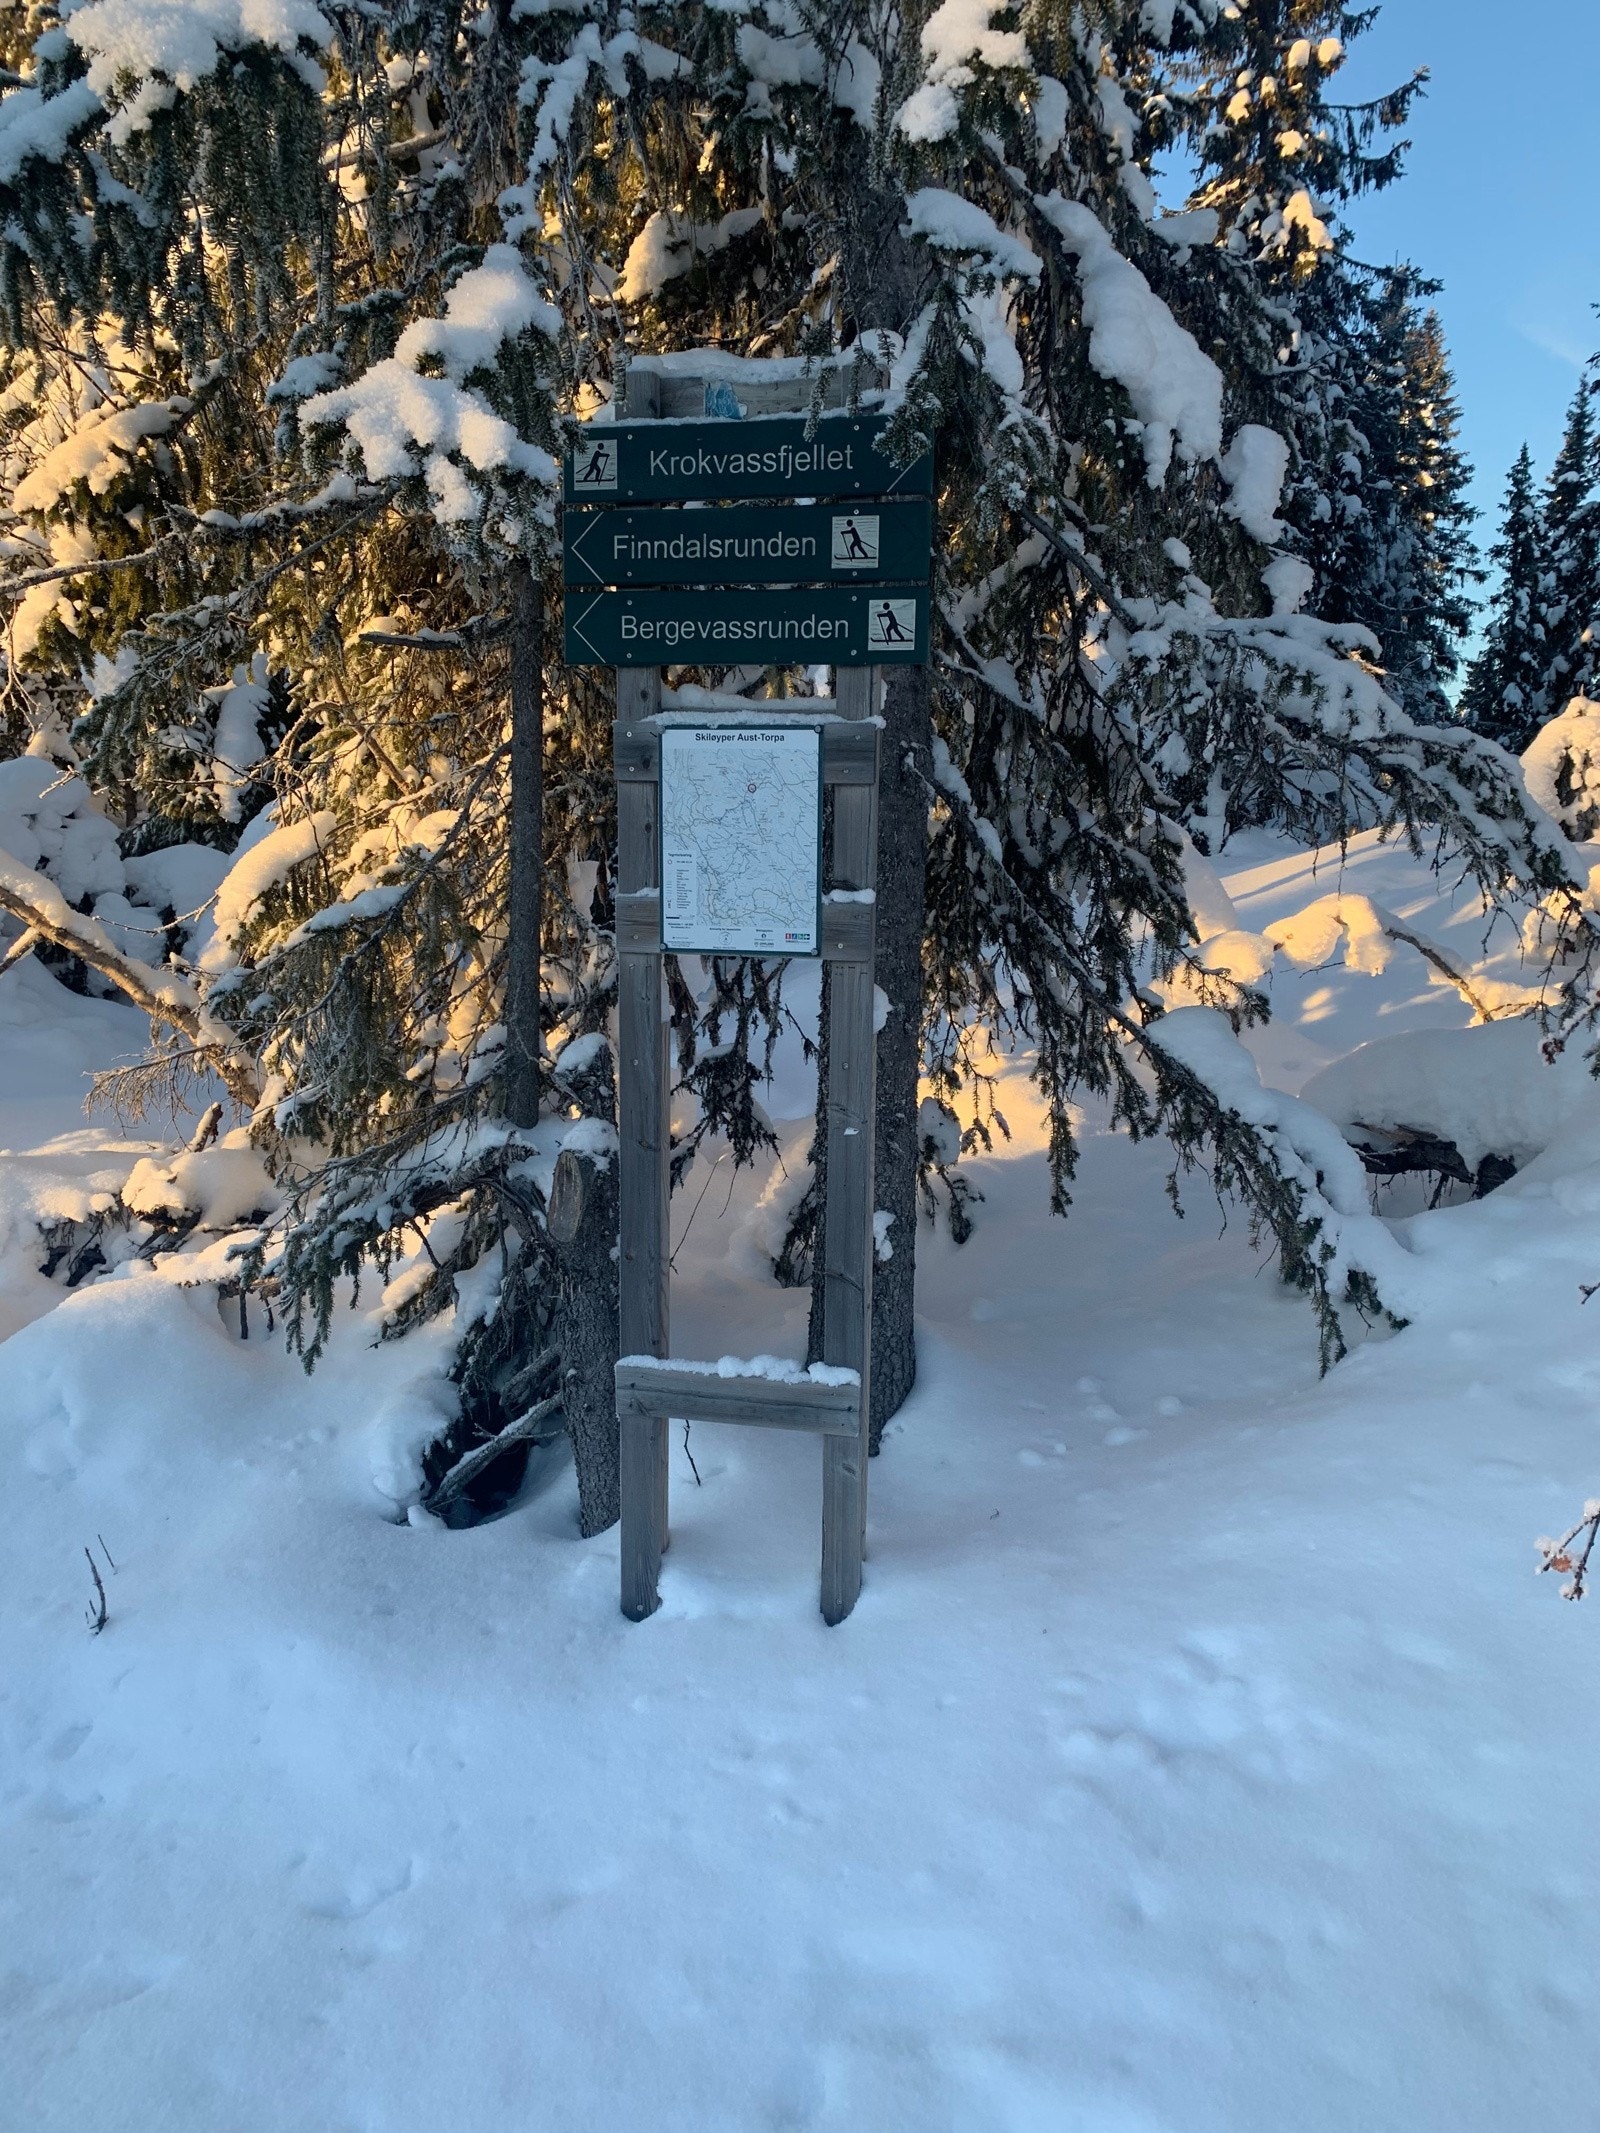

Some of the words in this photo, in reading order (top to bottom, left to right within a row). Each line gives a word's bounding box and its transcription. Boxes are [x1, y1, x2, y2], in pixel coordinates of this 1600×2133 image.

[649, 443, 854, 478] Krokvassfjellet
[613, 531, 816, 560] Finndalsrunden
[621, 614, 849, 645] Bergevassrunden
[695, 733, 735, 743] Skiløyper
[737, 733, 785, 743] Aust-Torpa
